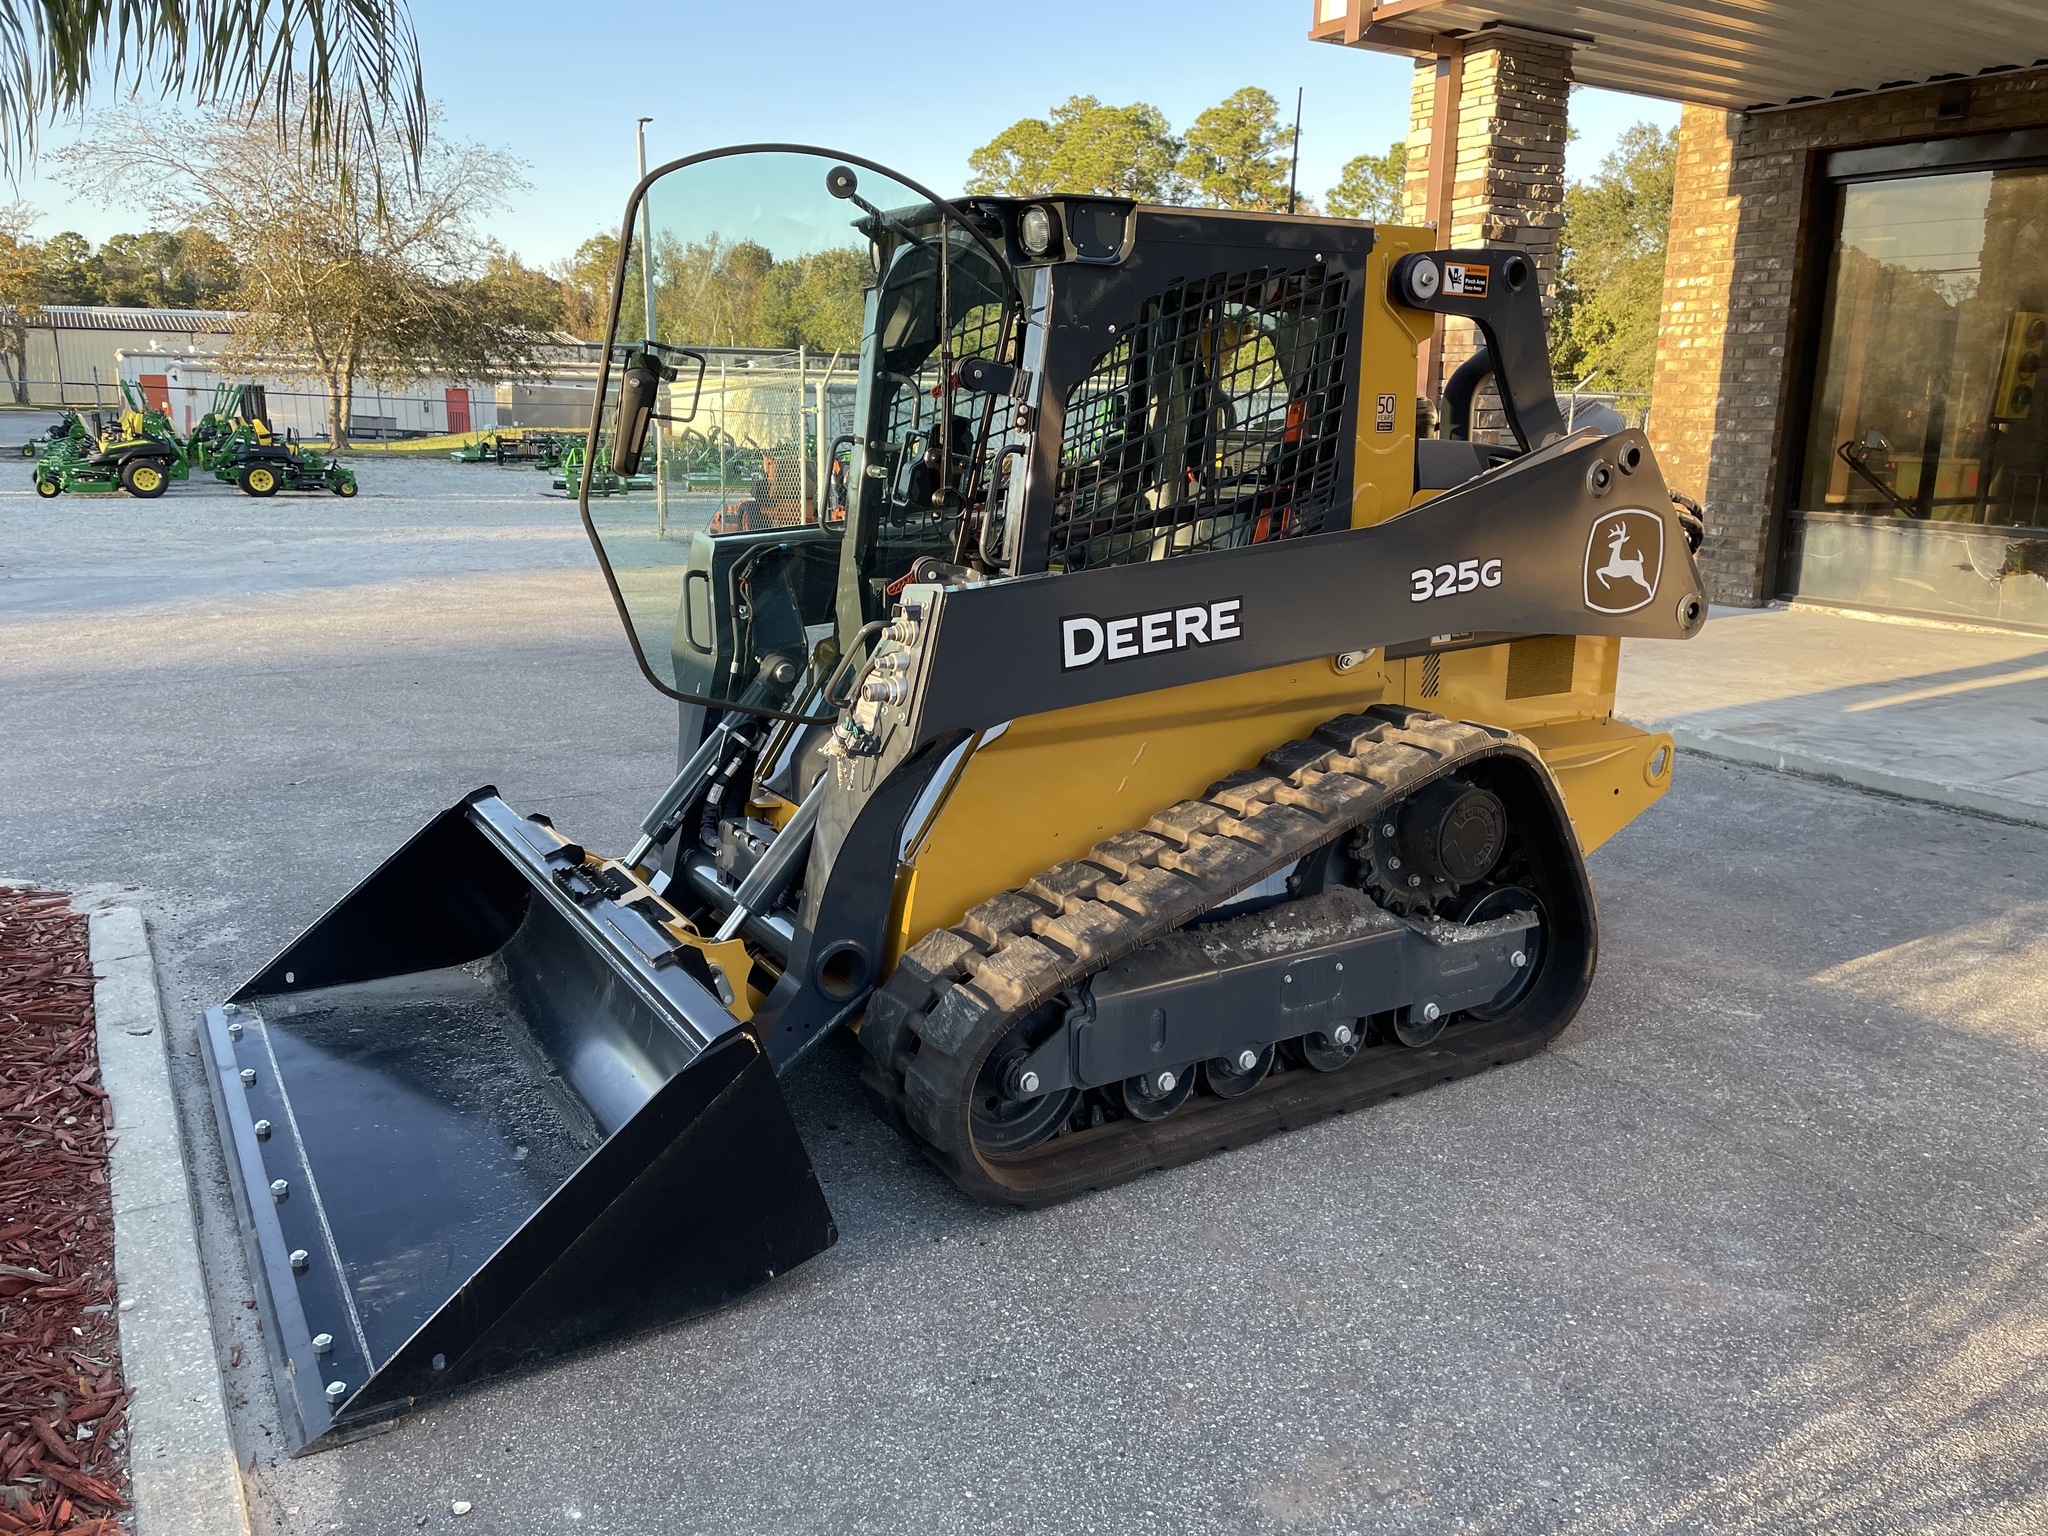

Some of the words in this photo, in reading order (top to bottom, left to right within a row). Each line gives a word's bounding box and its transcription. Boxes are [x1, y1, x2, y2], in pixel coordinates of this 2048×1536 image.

[1377, 396, 1395, 414] 50
[1411, 559, 1502, 602] 325G
[1062, 599, 1241, 668] DEERE
